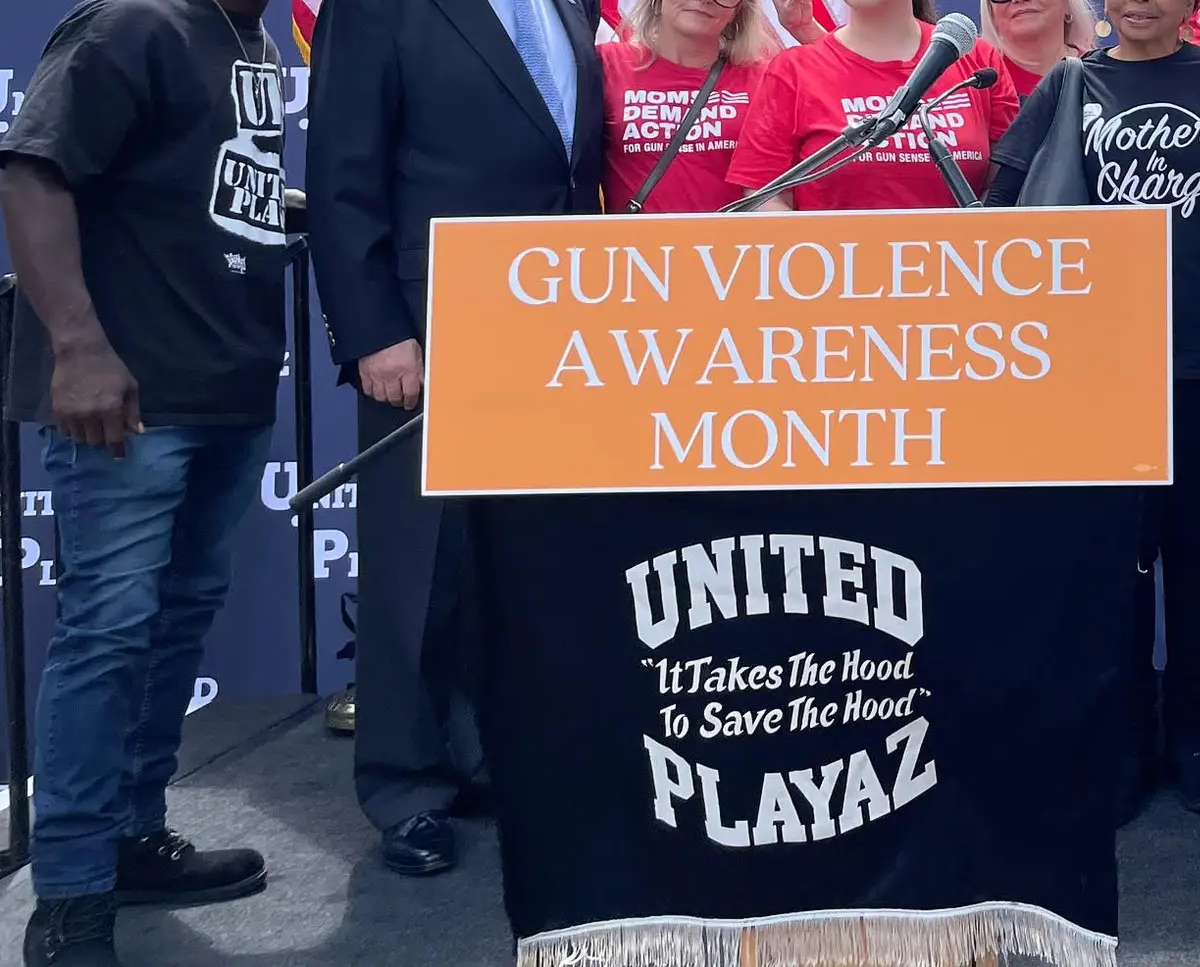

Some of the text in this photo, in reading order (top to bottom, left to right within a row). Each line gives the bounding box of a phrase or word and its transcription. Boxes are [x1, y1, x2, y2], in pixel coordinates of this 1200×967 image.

[623, 105, 737, 123] DEMND
[841, 96, 897, 113] MO
[846, 112, 965, 131] DAND
[623, 122, 722, 141] ACTON
[624, 144, 641, 153] FOR
[644, 142, 664, 152] GUN
[853, 150, 982, 163] OR GUN SENSE MERICA
[1146, 149, 1167, 172] In
[224, 158, 281, 200] UNIT
[229, 186, 281, 226] PLA
[508, 238, 1093, 305] GUN VIOLENCE
[545, 321, 1052, 388] AWARENESS
[649, 407, 947, 470] MONTH
[625, 533, 924, 650] UNITED
[684, 656, 783, 694] Takes
[787, 650, 836, 690] The
[842, 648, 915, 683] Hood
[659, 703, 690, 740] To
[700, 701, 783, 740] Save
[787, 696, 836, 733] The
[643, 715, 938, 848] PLAYAZ
